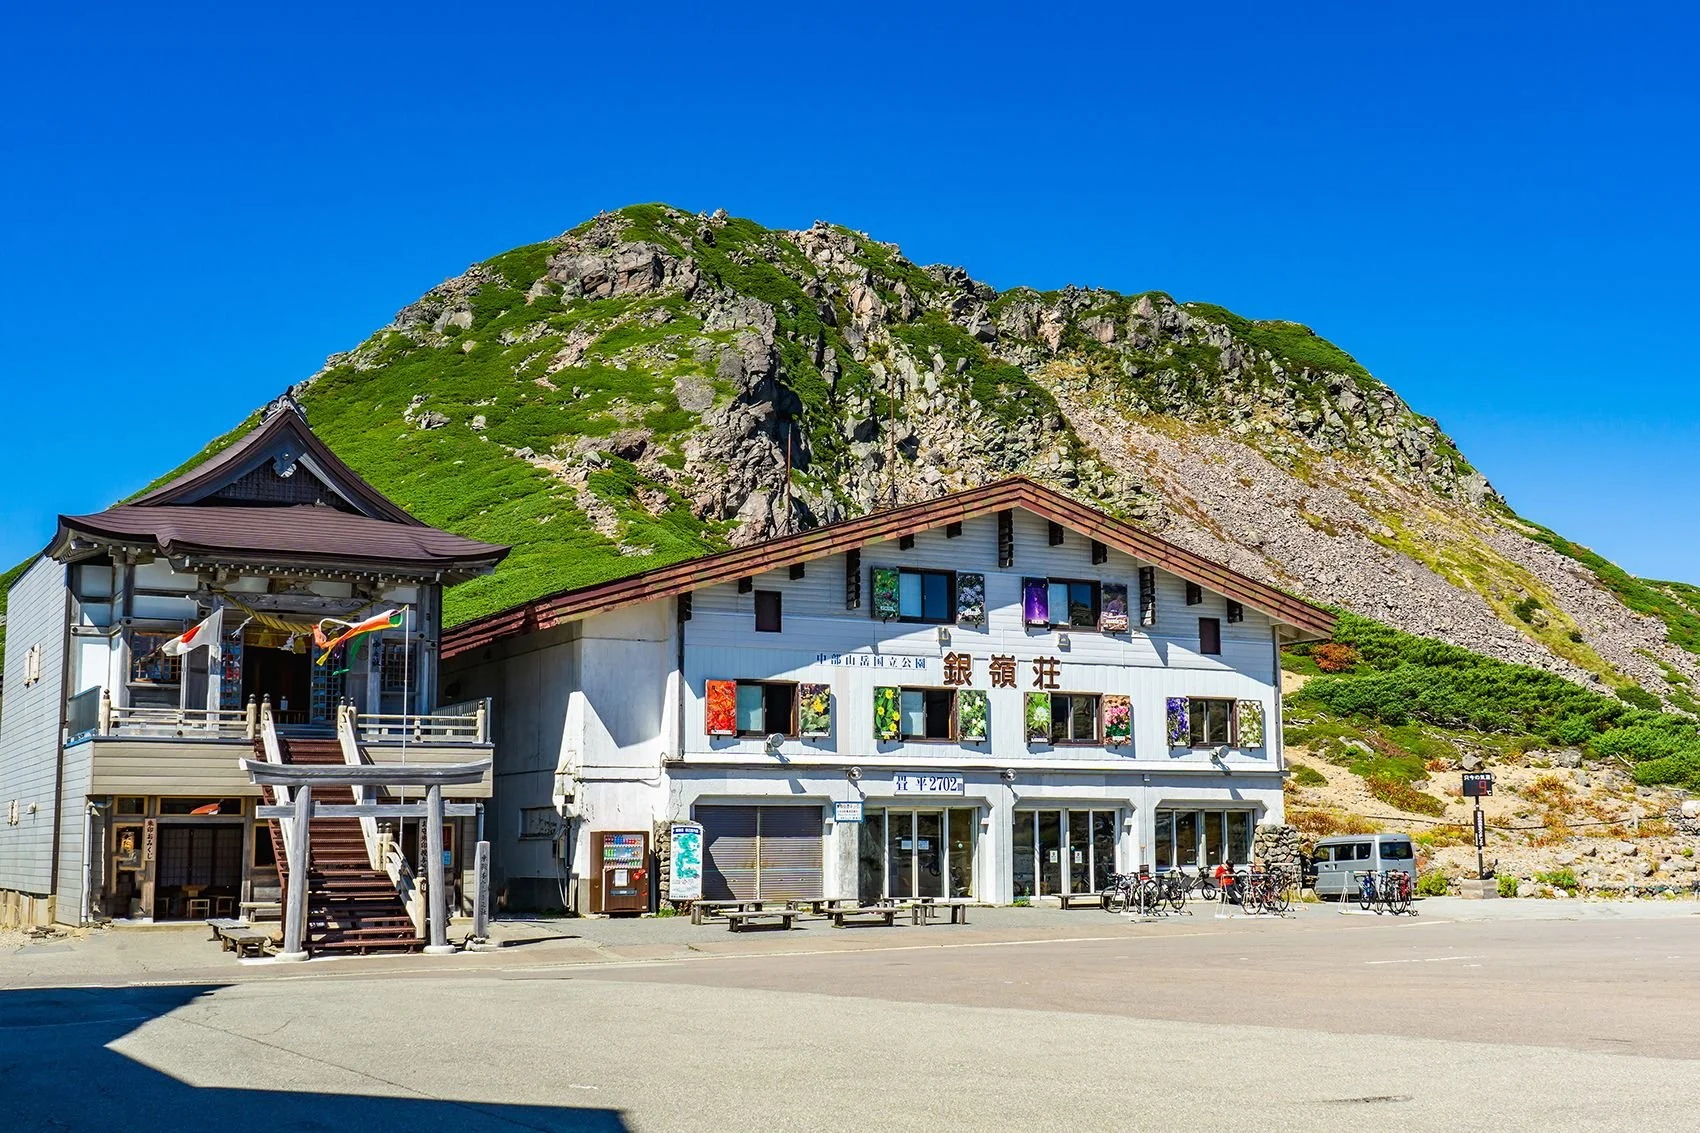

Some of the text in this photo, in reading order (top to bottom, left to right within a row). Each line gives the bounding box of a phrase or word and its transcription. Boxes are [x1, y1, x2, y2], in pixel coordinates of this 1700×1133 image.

[816, 652, 926, 669] 中部山岳国立公園
[943, 652, 1060, 689] 銀嶺荘
